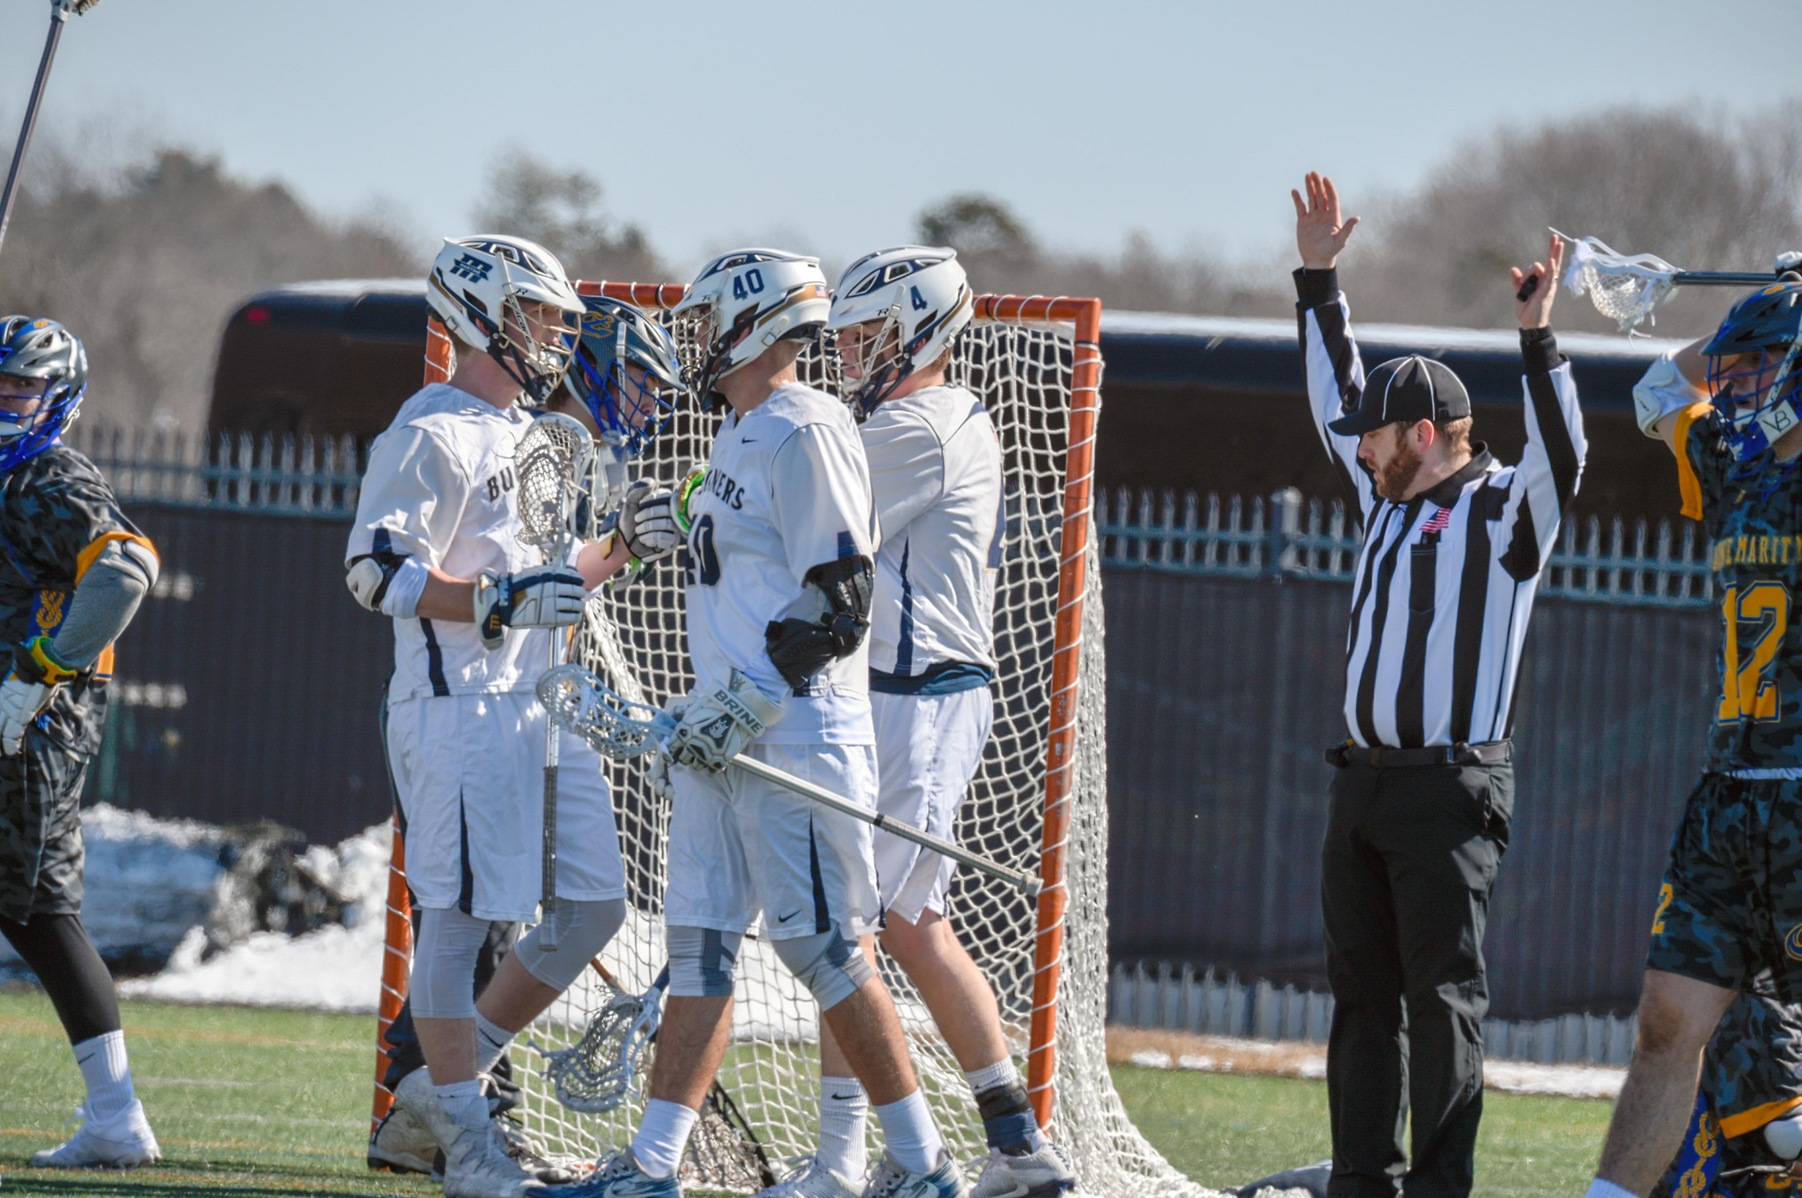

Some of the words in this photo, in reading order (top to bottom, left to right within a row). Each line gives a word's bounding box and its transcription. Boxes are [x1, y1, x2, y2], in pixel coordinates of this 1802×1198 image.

[732, 267, 765, 301] 40
[910, 285, 928, 311] 4
[1763, 409, 1792, 432] VB
[487, 467, 515, 503] BU
[1717, 580, 1793, 725] 12
[714, 689, 764, 734] BRINE
